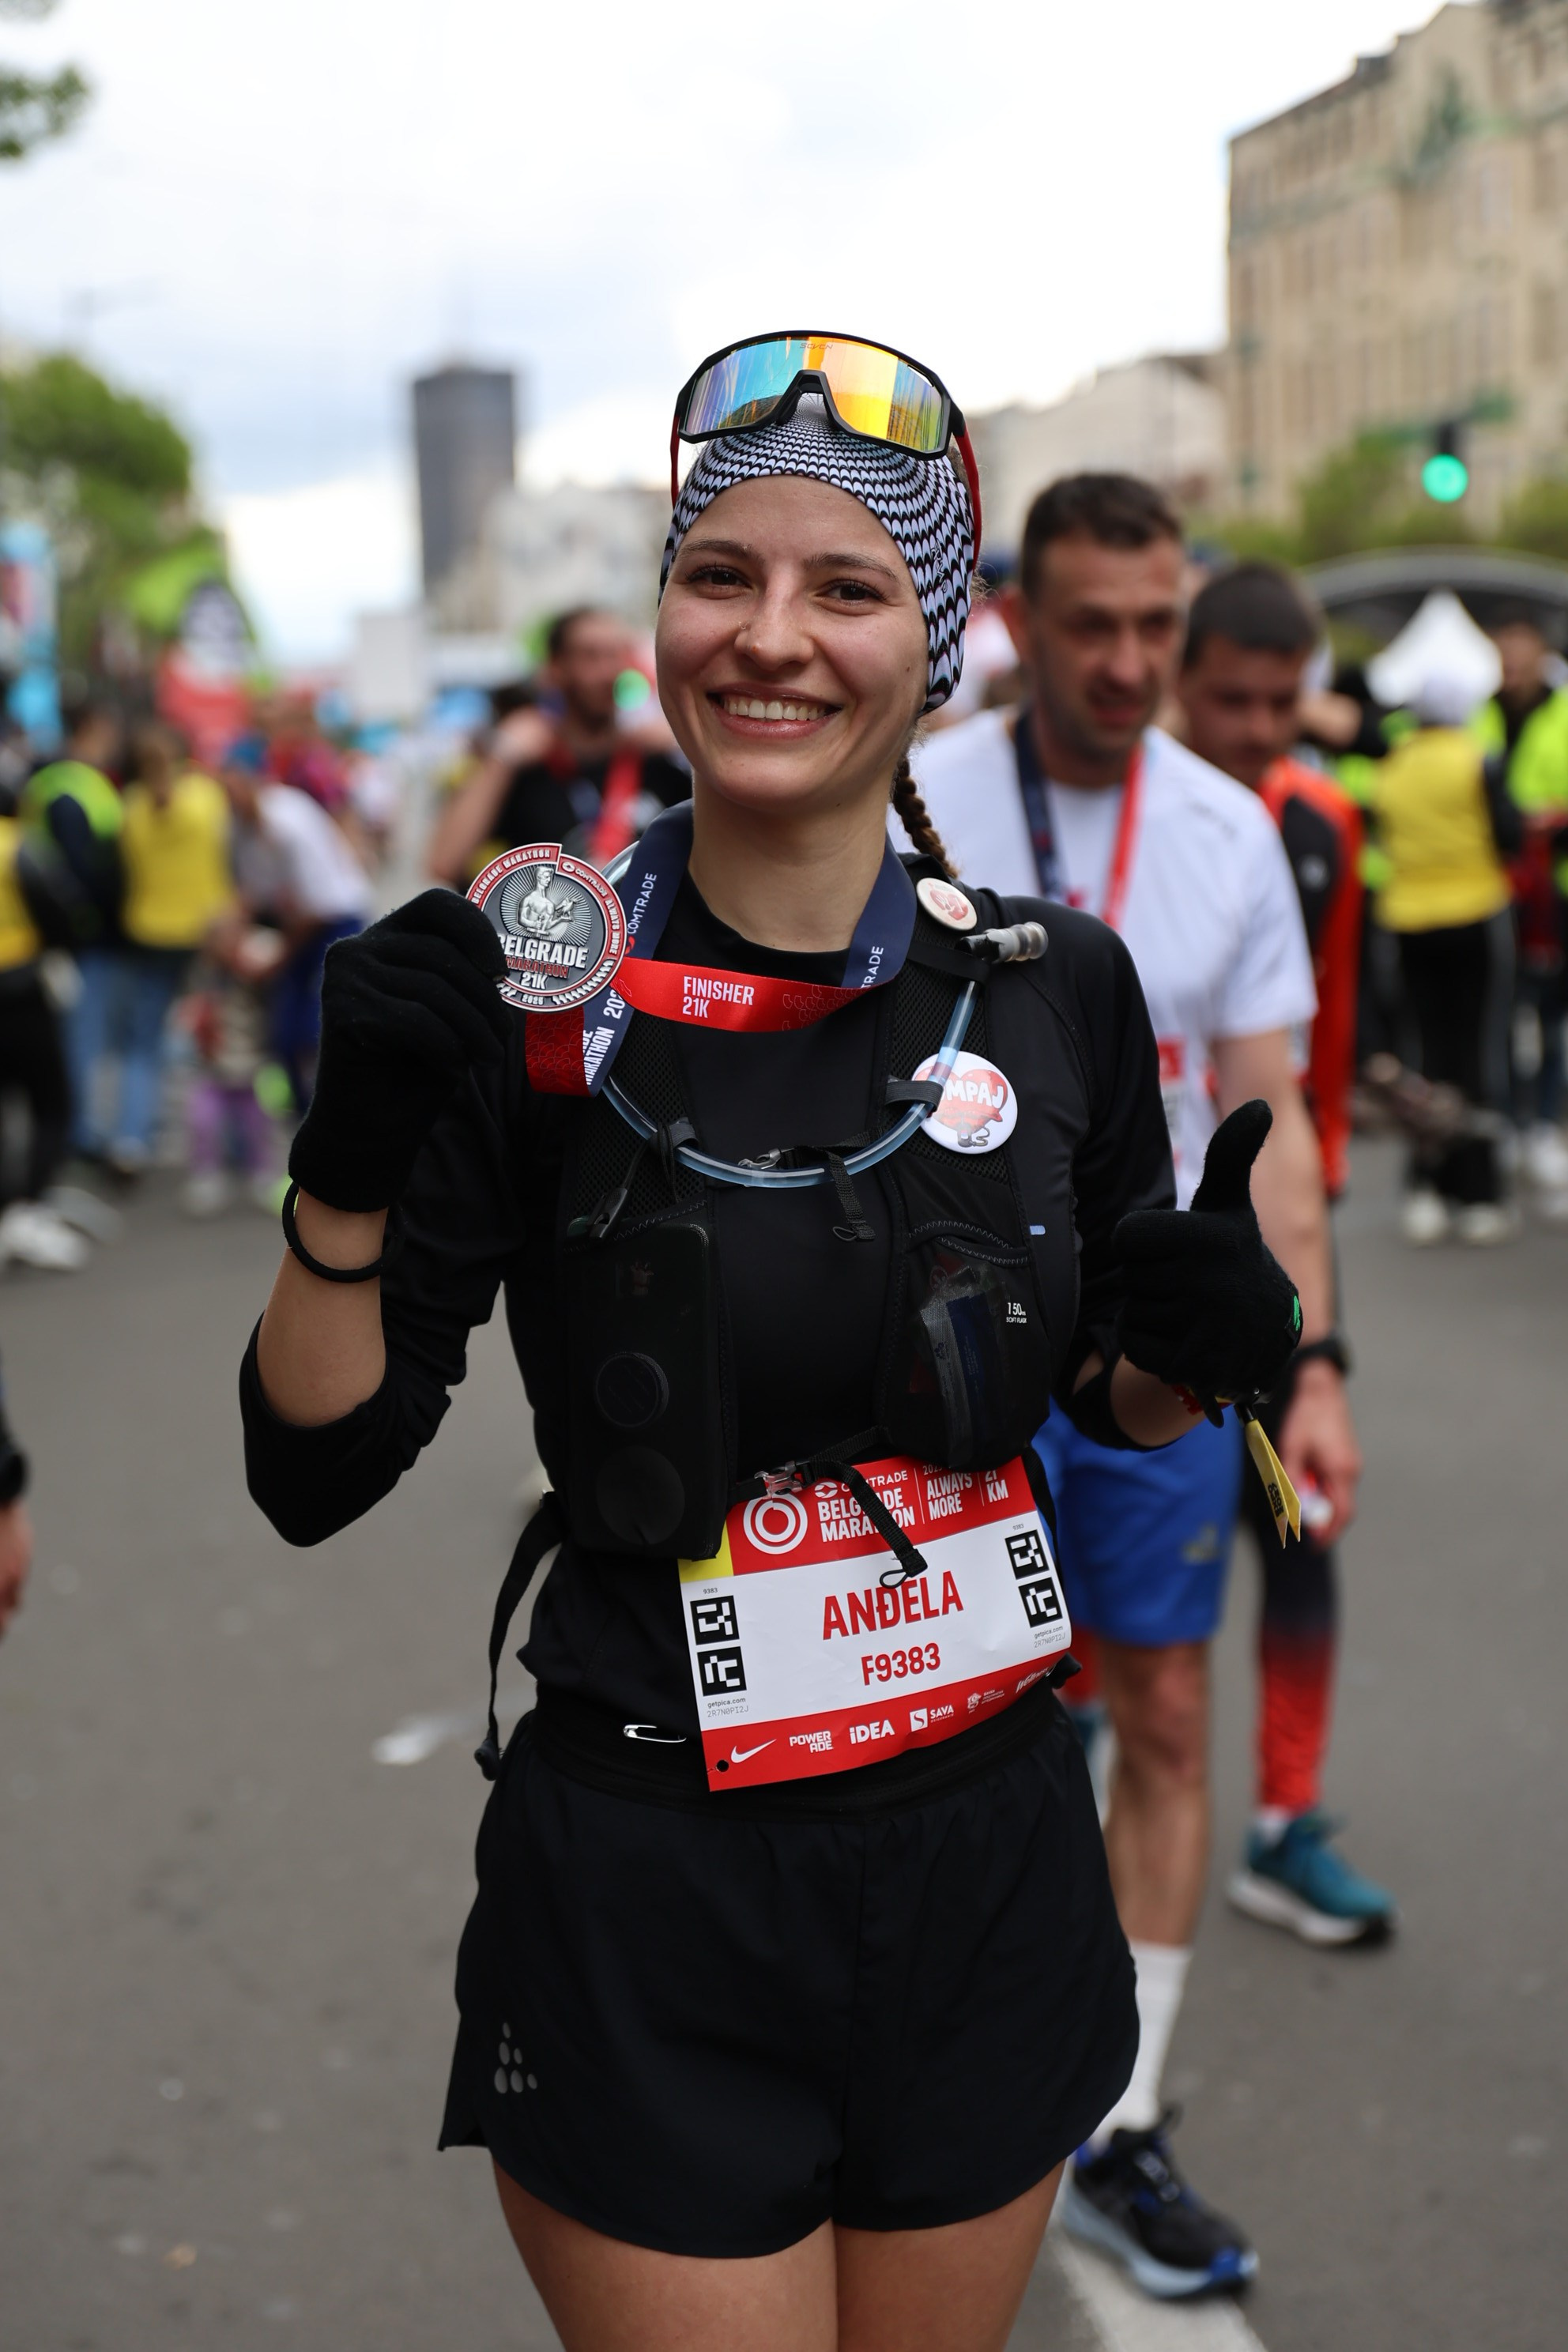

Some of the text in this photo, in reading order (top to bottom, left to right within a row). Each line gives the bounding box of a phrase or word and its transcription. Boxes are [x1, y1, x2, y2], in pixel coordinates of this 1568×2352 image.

[471, 849, 550, 904] BELGRADE MARATHON
[575, 868, 620, 956] COMTRADE ALWAYS MORE
[627, 873, 657, 934] COMTRADE
[506, 955, 569, 979] MARATHON
[521, 971, 549, 989] 21K
[861, 945, 884, 989] TRADE
[522, 994, 545, 1005] 2025
[683, 975, 755, 1006] FINISHER
[603, 989, 626, 1020] 202
[682, 996, 710, 1019] 21K
[941, 1078, 1004, 1109] MPAJ
[841, 1470, 908, 1492] CTRADE
[922, 1464, 943, 1476] 202
[927, 1472, 973, 1501] ALWAYS
[986, 1479, 1009, 1503] KM
[817, 1487, 904, 1522] BELGDE
[928, 1493, 963, 1521] MORE
[820, 1505, 915, 1543] MARAON
[1012, 1523, 1025, 1532] 9383
[823, 1570, 964, 1640] ANĐELA
[1034, 1625, 1064, 1639] getpica.com
[861, 1642, 941, 1686] F9383
[707, 1698, 746, 1709] getpica.com
[930, 1704, 954, 1720] SAVA
[789, 1730, 831, 1747] POWER
[809, 1740, 833, 1754] ADE
